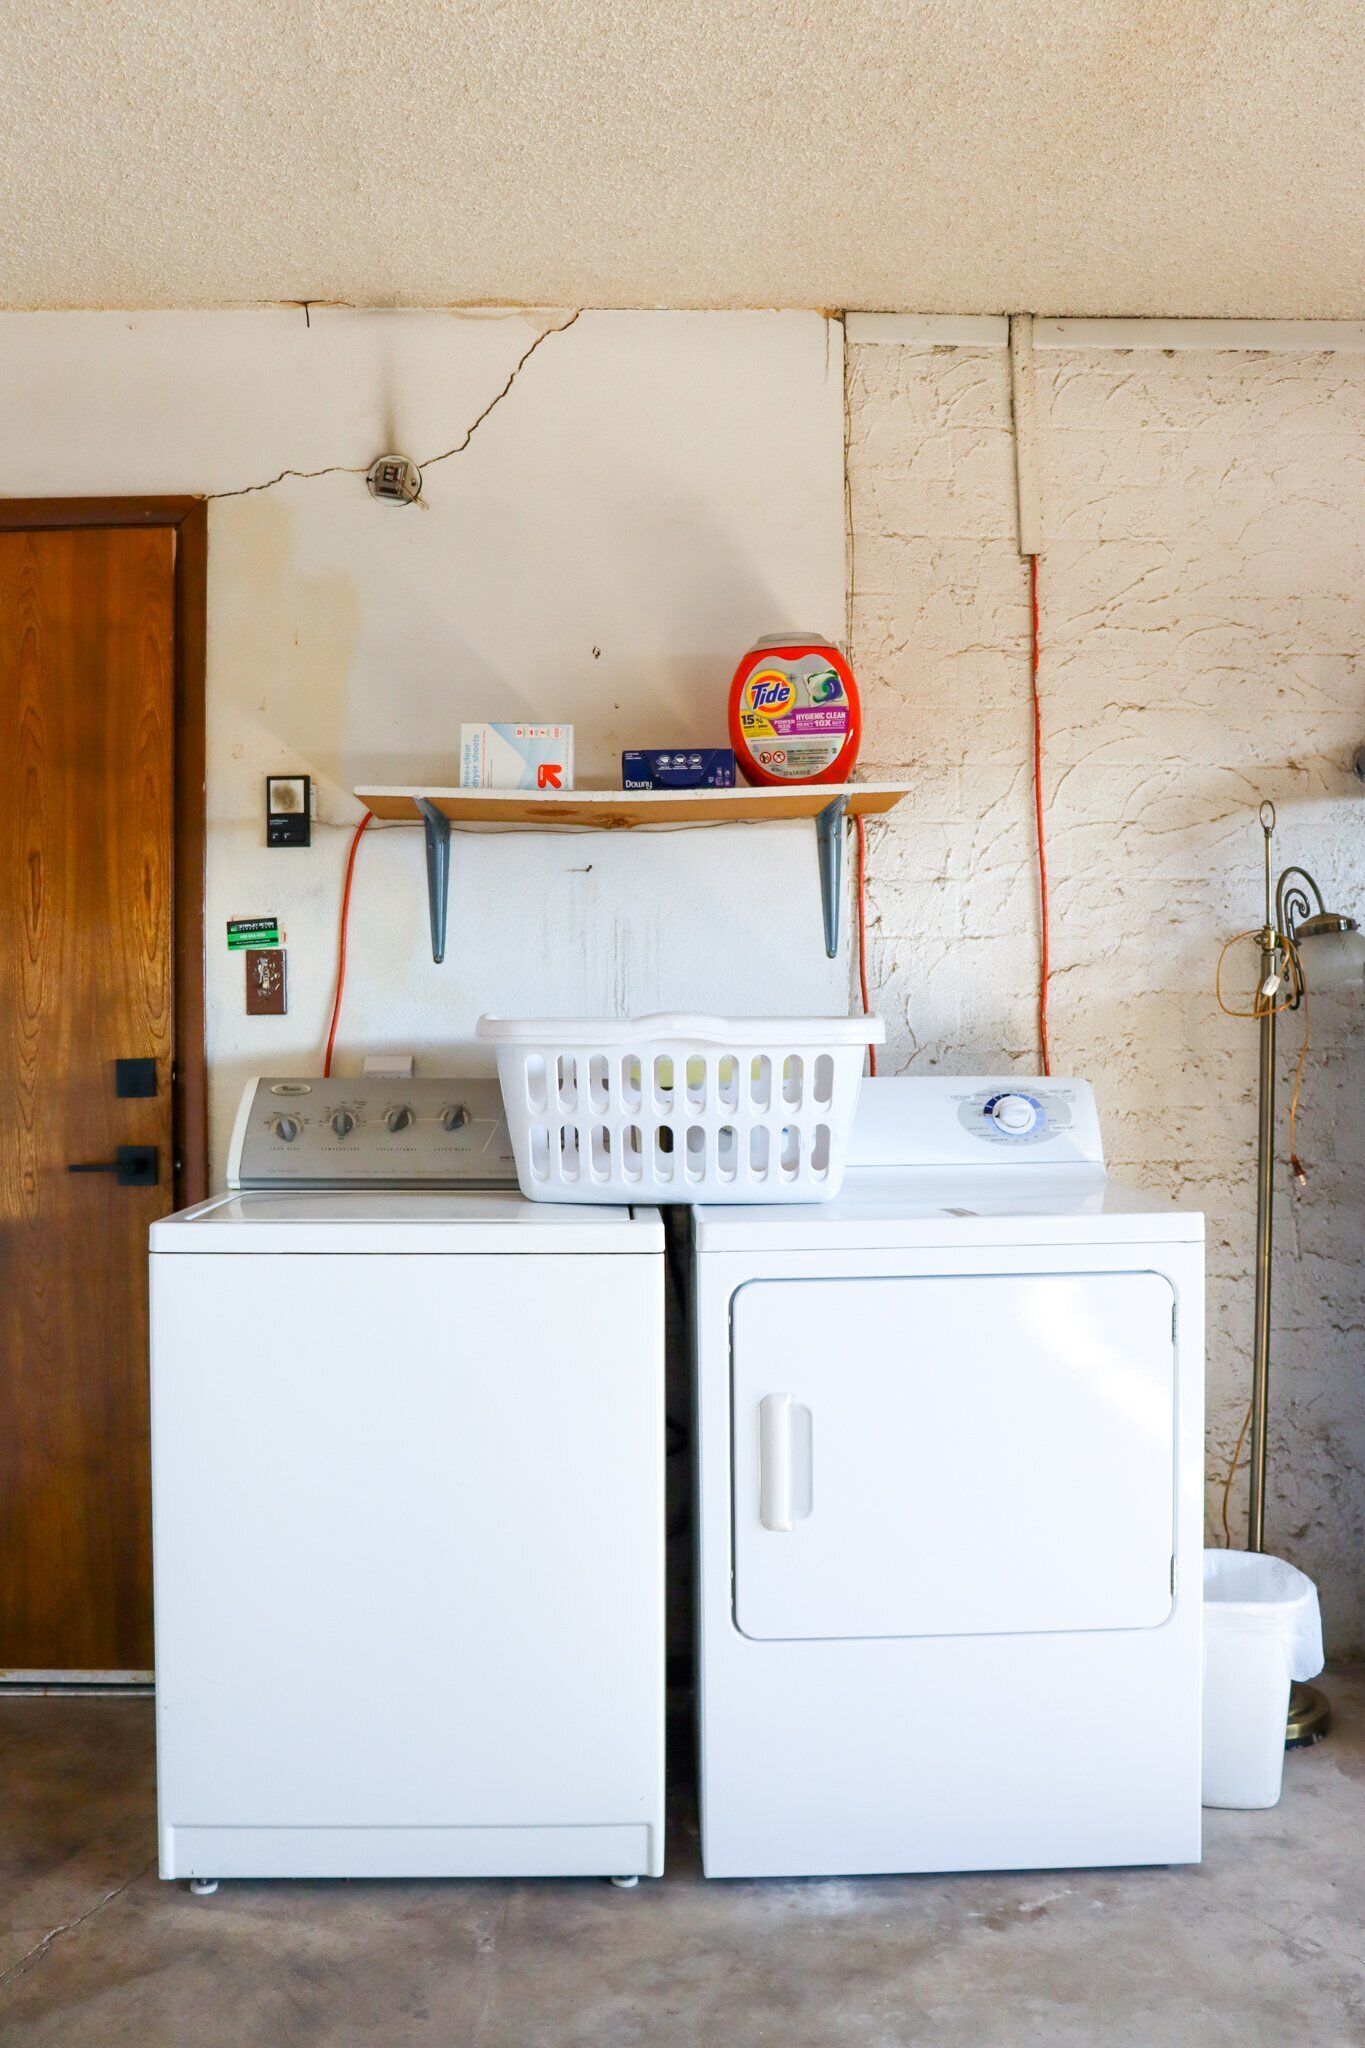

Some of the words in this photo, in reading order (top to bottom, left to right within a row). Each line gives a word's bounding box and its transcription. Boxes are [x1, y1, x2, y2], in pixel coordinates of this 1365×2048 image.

[751, 683, 790, 710] Tide
[796, 712, 825, 720] HYGIENIC
[826, 712, 846, 720] CLEAN
[625, 780, 652, 790] Downy
